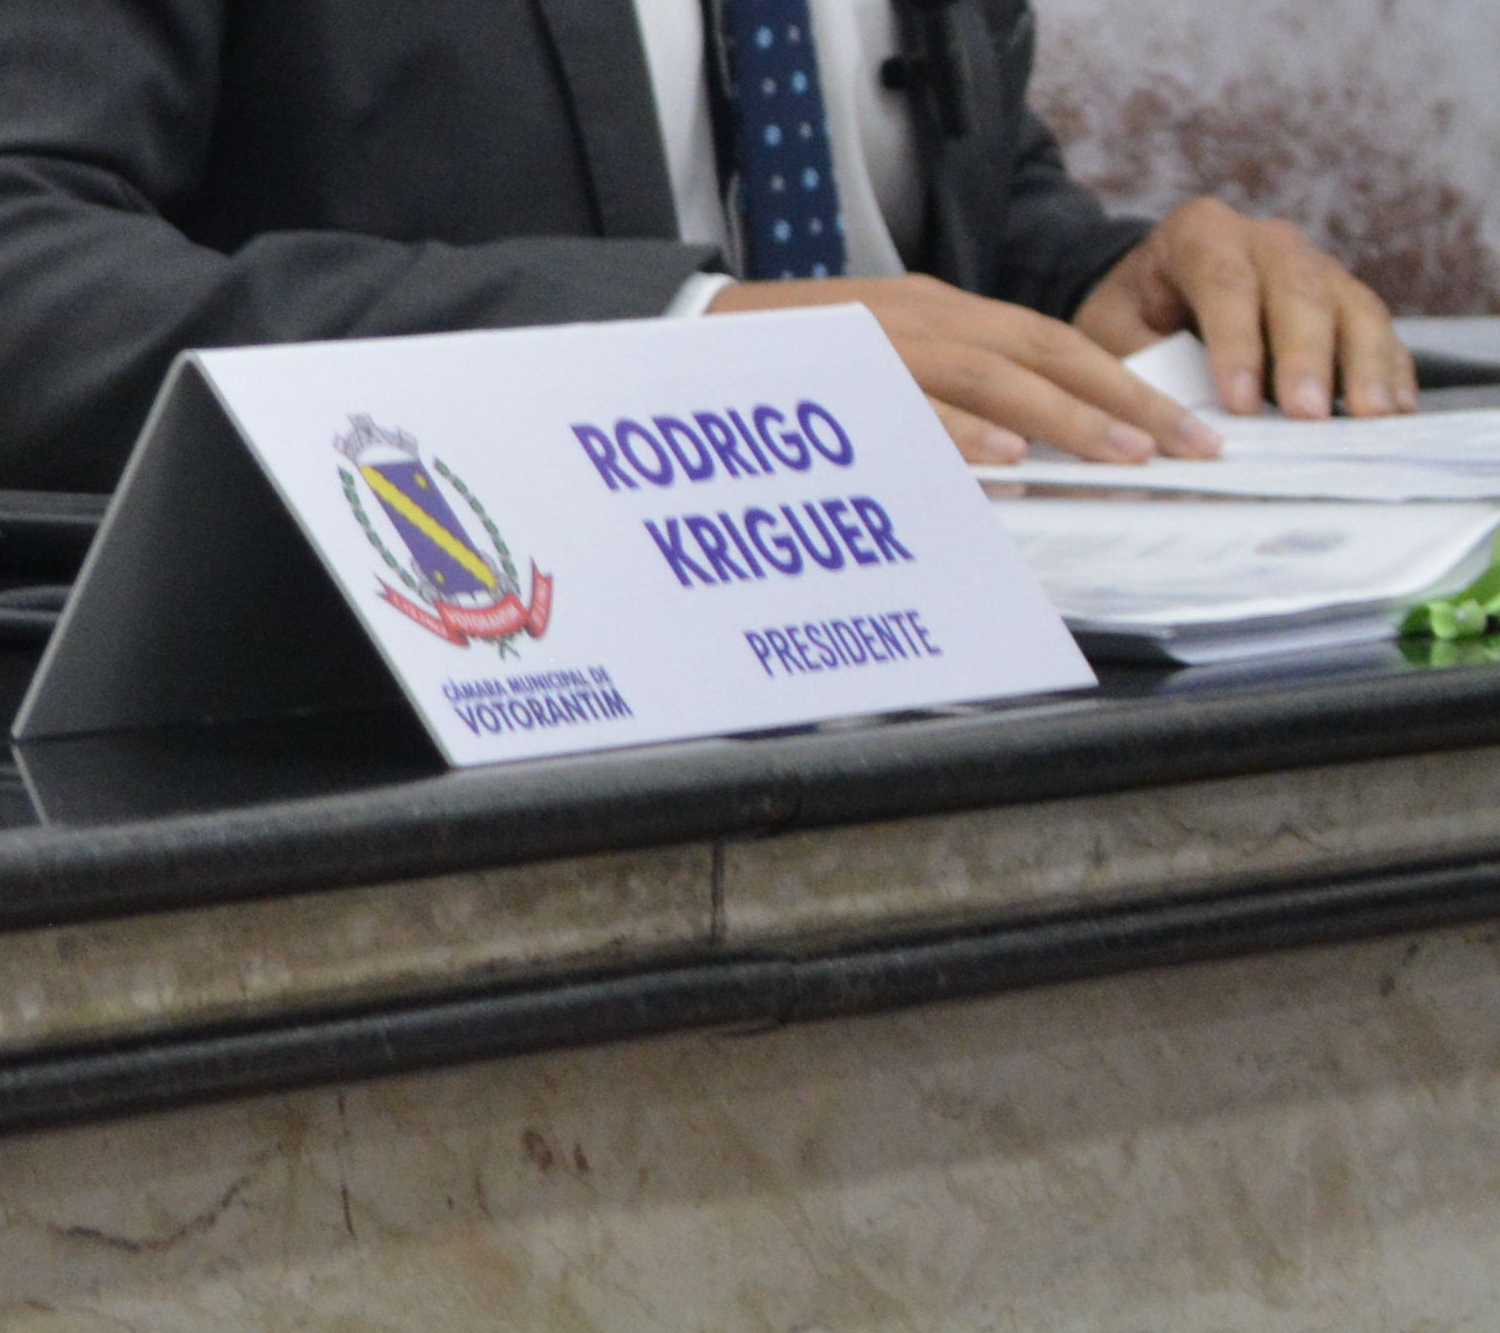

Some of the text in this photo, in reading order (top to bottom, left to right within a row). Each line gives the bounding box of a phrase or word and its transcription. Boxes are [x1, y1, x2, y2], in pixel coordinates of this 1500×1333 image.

[569, 397, 856, 492] RODRIGO
[641, 494, 916, 588] KRIGUER
[742, 608, 943, 678] PRESIDENTE
[453, 687, 634, 737] VOTORANTIM
[506, 668, 590, 694] MUNICIPAL
[587, 664, 613, 684] DE
